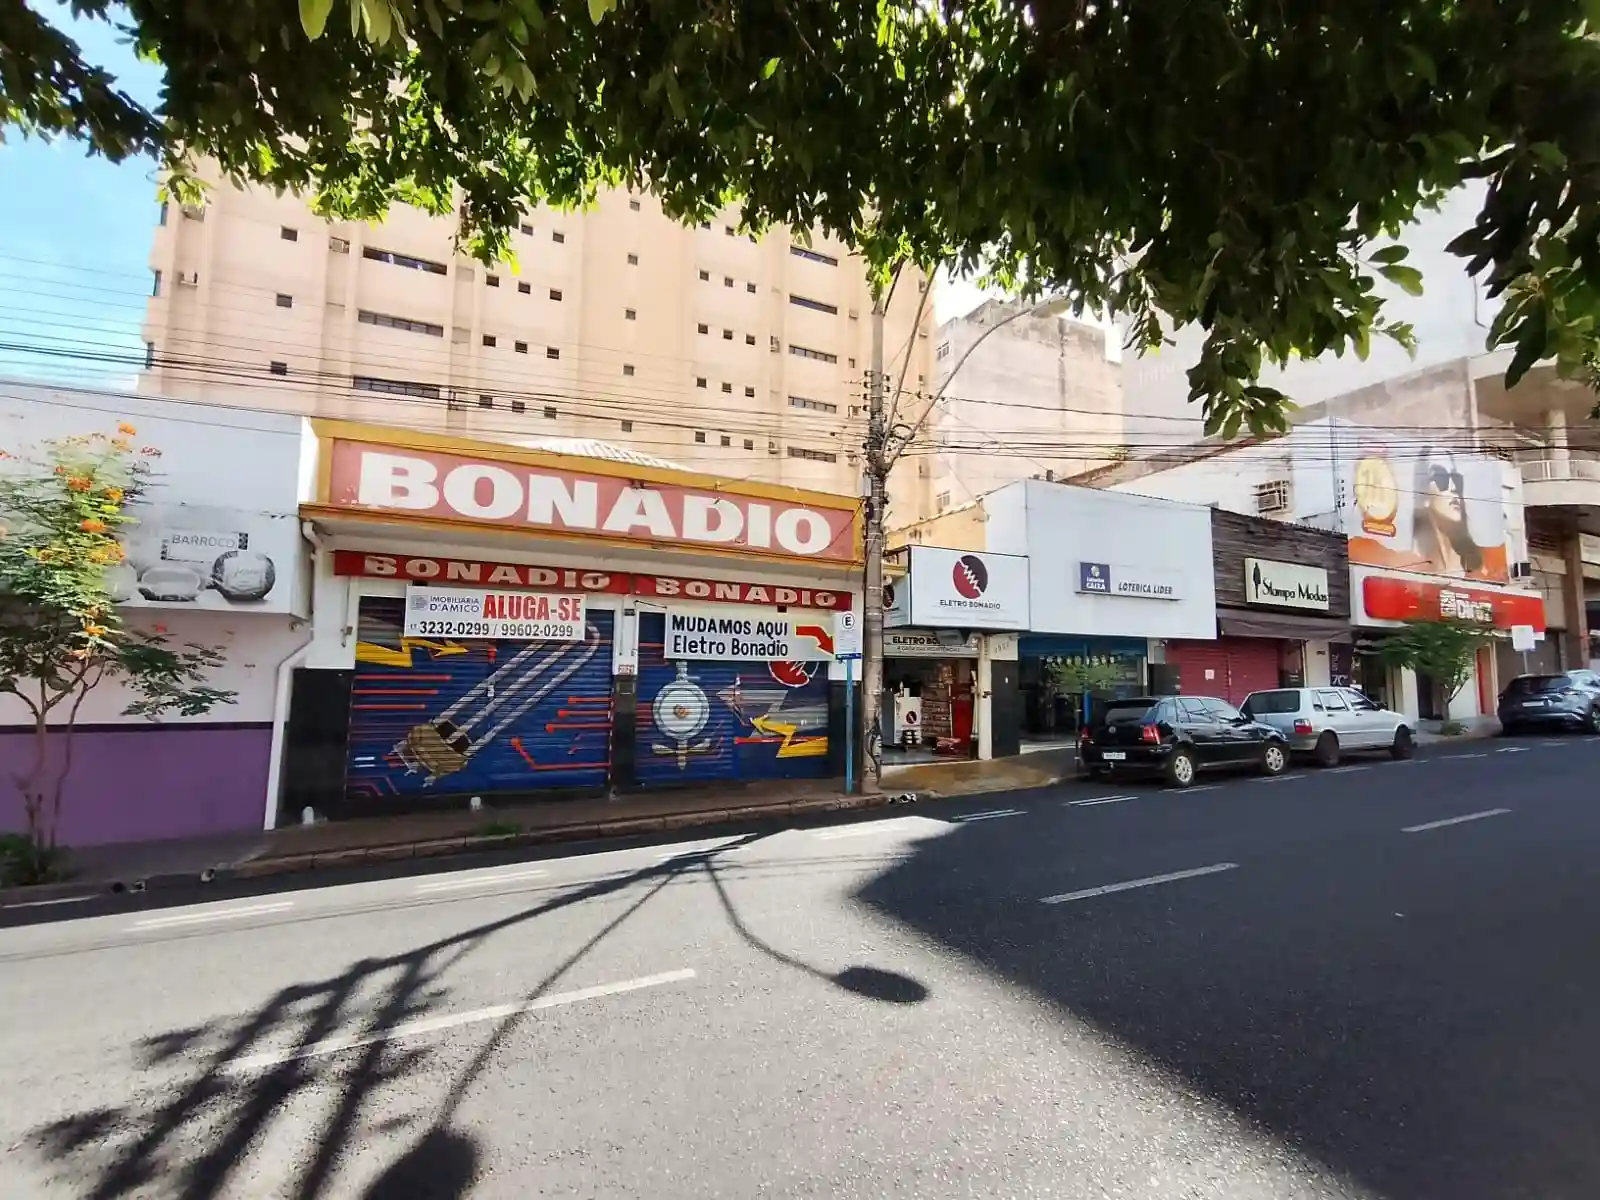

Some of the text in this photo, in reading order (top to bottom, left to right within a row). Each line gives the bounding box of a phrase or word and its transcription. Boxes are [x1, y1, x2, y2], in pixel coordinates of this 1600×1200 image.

[358, 451, 832, 555] BONADIO
[172, 534, 237, 548] BARROCO
[364, 555, 611, 590] BONADIO
[655, 577, 837, 607] BONADIO
[1297, 581, 1328, 602] Modas
[429, 604, 480, 613] D'AMICO
[483, 594, 581, 622] ALUGA-SE
[969, 601, 1001, 609] BONADIO
[419, 620, 490, 636] 3232-0299
[500, 624, 573, 637] 99602-0299
[671, 614, 789, 638] MUDAMOS AQUI
[845, 616, 851, 626] E
[673, 635, 788, 657] Eletro Bonadio
[892, 635, 926, 645] ELETRO
